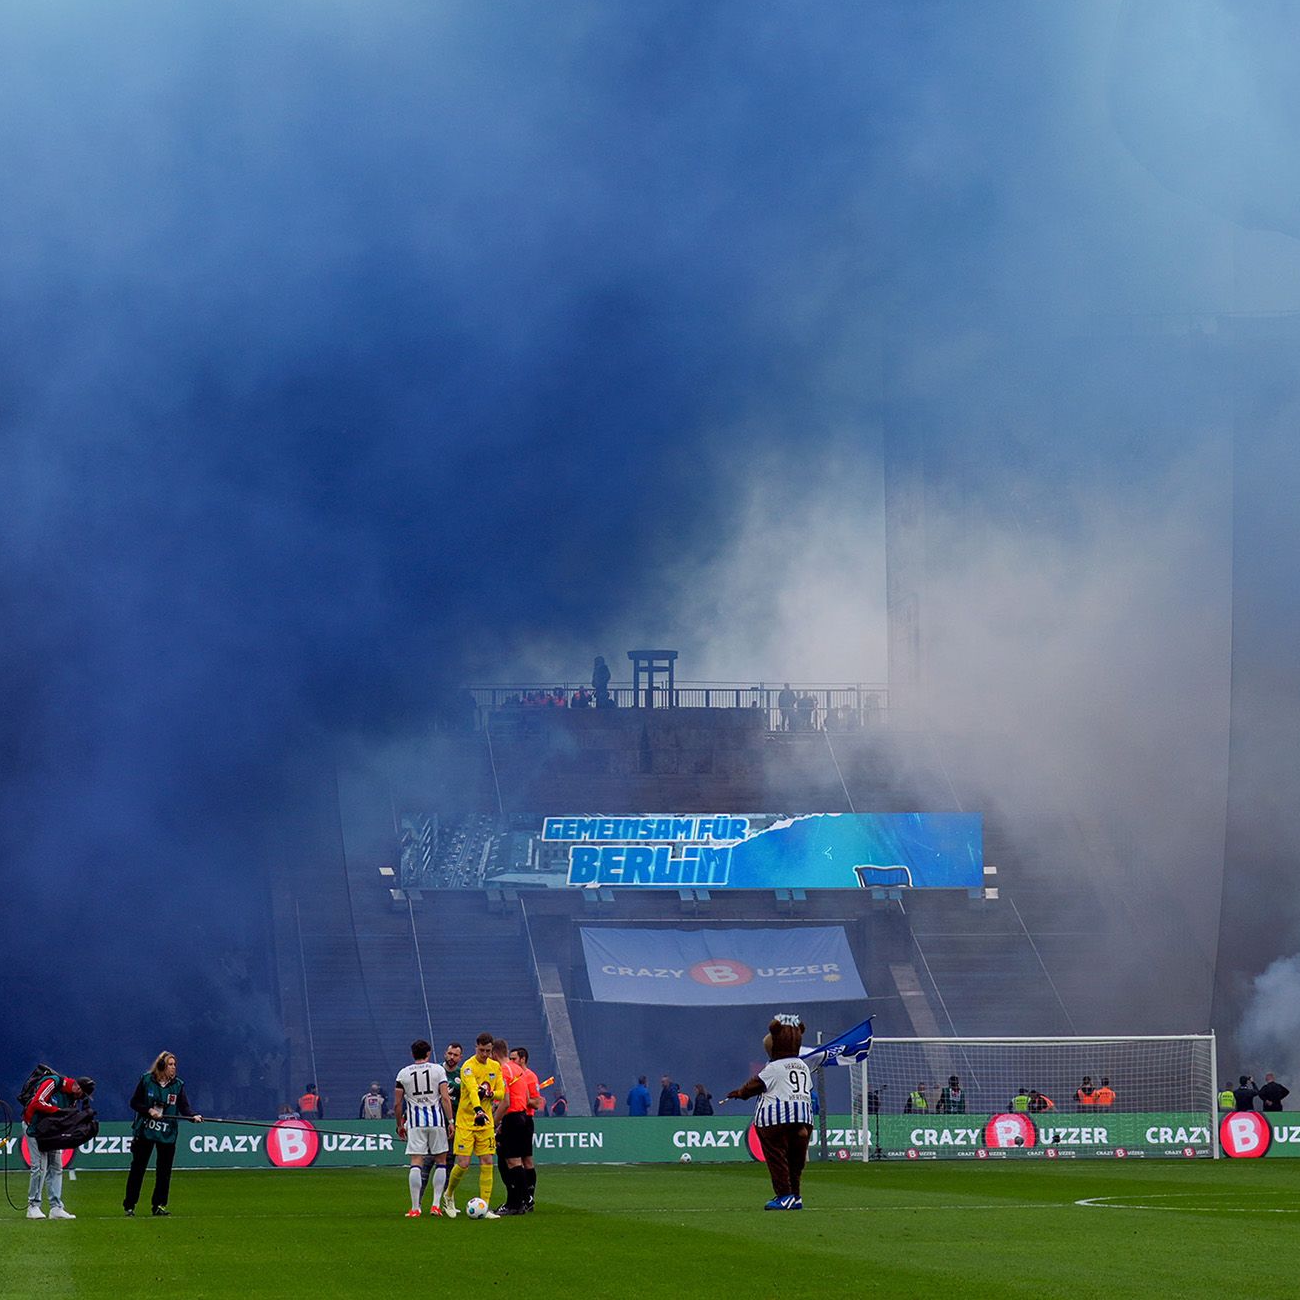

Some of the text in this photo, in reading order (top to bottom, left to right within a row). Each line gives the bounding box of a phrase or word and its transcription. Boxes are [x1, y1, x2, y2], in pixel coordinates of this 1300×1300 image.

[544, 814, 749, 841] GEMEINSAM FÜR
[602, 964, 684, 980] CRAZY
[410, 1069, 433, 1096] 11
[789, 1070, 809, 1095] 92
[190, 1135, 262, 1153] CRAZY
[532, 1132, 603, 1148] WETTEN
[673, 1130, 744, 1148] CRAZY
[910, 1128, 980, 1146] CRAZY
